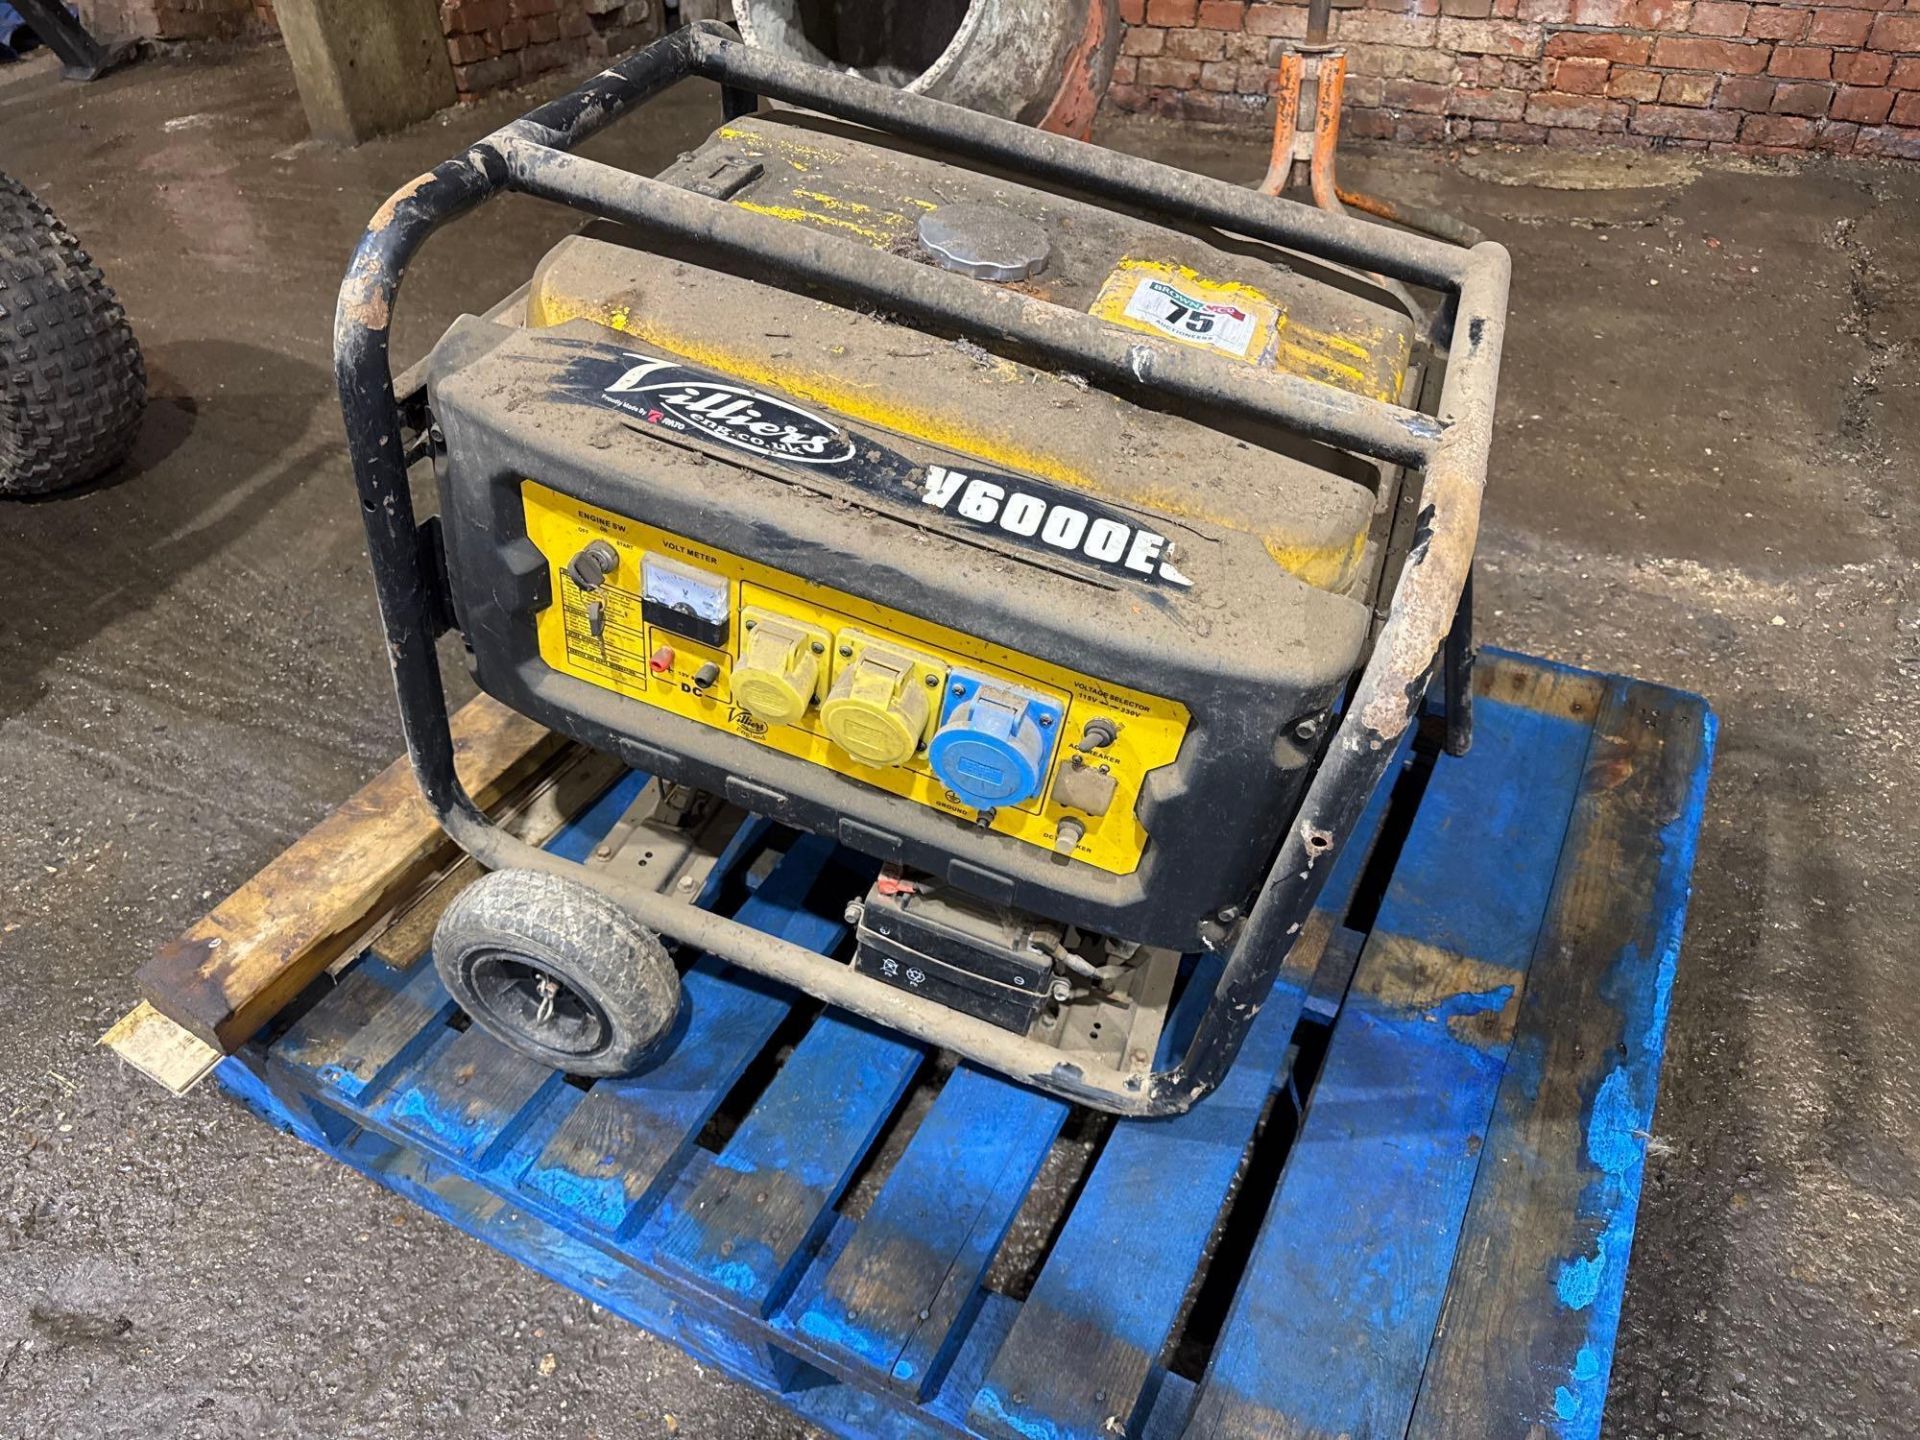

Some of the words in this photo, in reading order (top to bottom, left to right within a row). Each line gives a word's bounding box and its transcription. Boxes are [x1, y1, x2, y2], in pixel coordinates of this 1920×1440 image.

[1165, 299, 1215, 333] 75
[604, 352, 830, 453] Villiers
[623, 401, 639, 412] Made
[639, 406, 648, 416] By
[690, 413, 804, 455] eng.co.uk
[578, 510, 611, 528] ENGINE
[612, 522, 626, 533] SW
[616, 540, 634, 550] START
[662, 540, 685, 554] VOLT
[687, 548, 718, 565] METER
[681, 682, 703, 698] DC
[1074, 681, 1109, 699] VOLTAGE
[1109, 693, 1150, 713] SELECTOR
[728, 707, 764, 732] Villiers
[936, 800, 968, 816] GROUND
